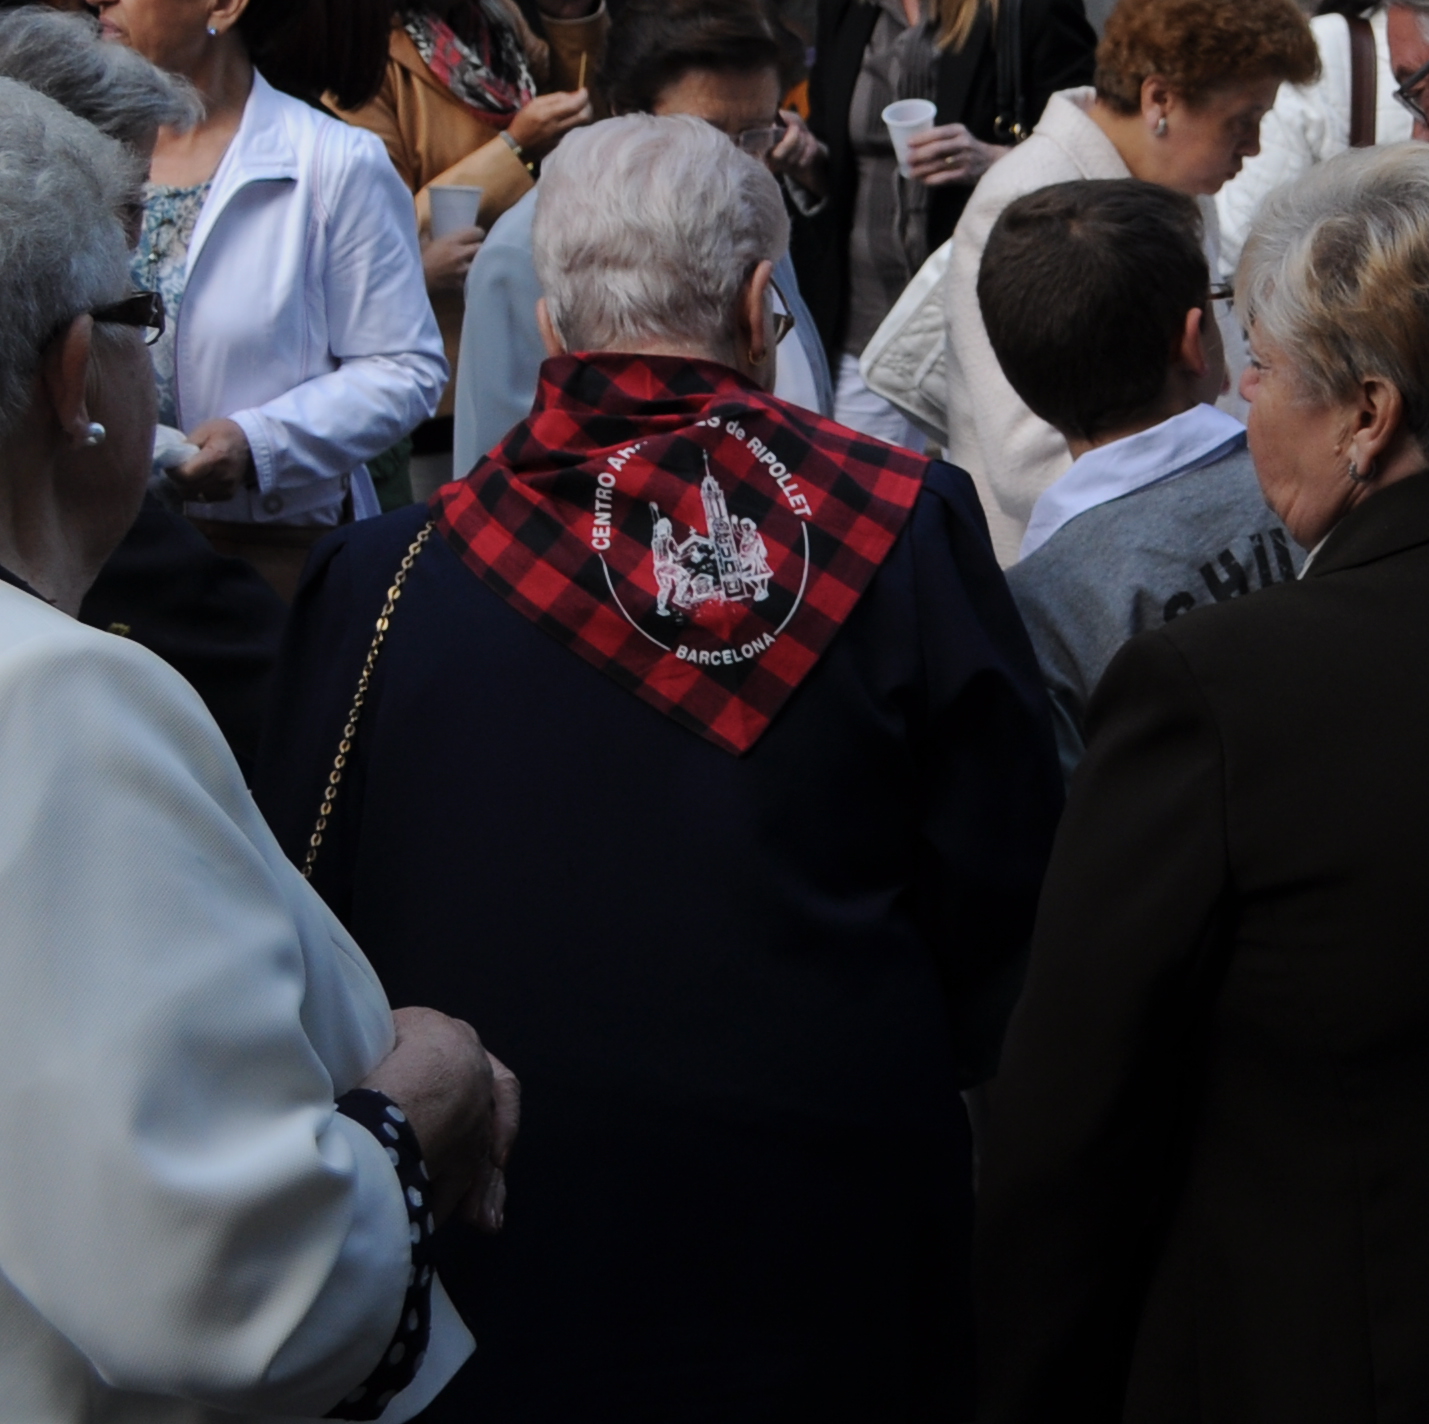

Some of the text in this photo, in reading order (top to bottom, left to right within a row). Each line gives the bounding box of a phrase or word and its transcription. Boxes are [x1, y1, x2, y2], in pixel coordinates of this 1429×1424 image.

[591, 472, 616, 550] CENTRO
[726, 420, 747, 441] de
[746, 436, 813, 517] RIPOLLET
[675, 631, 776, 667] BARCELONA
